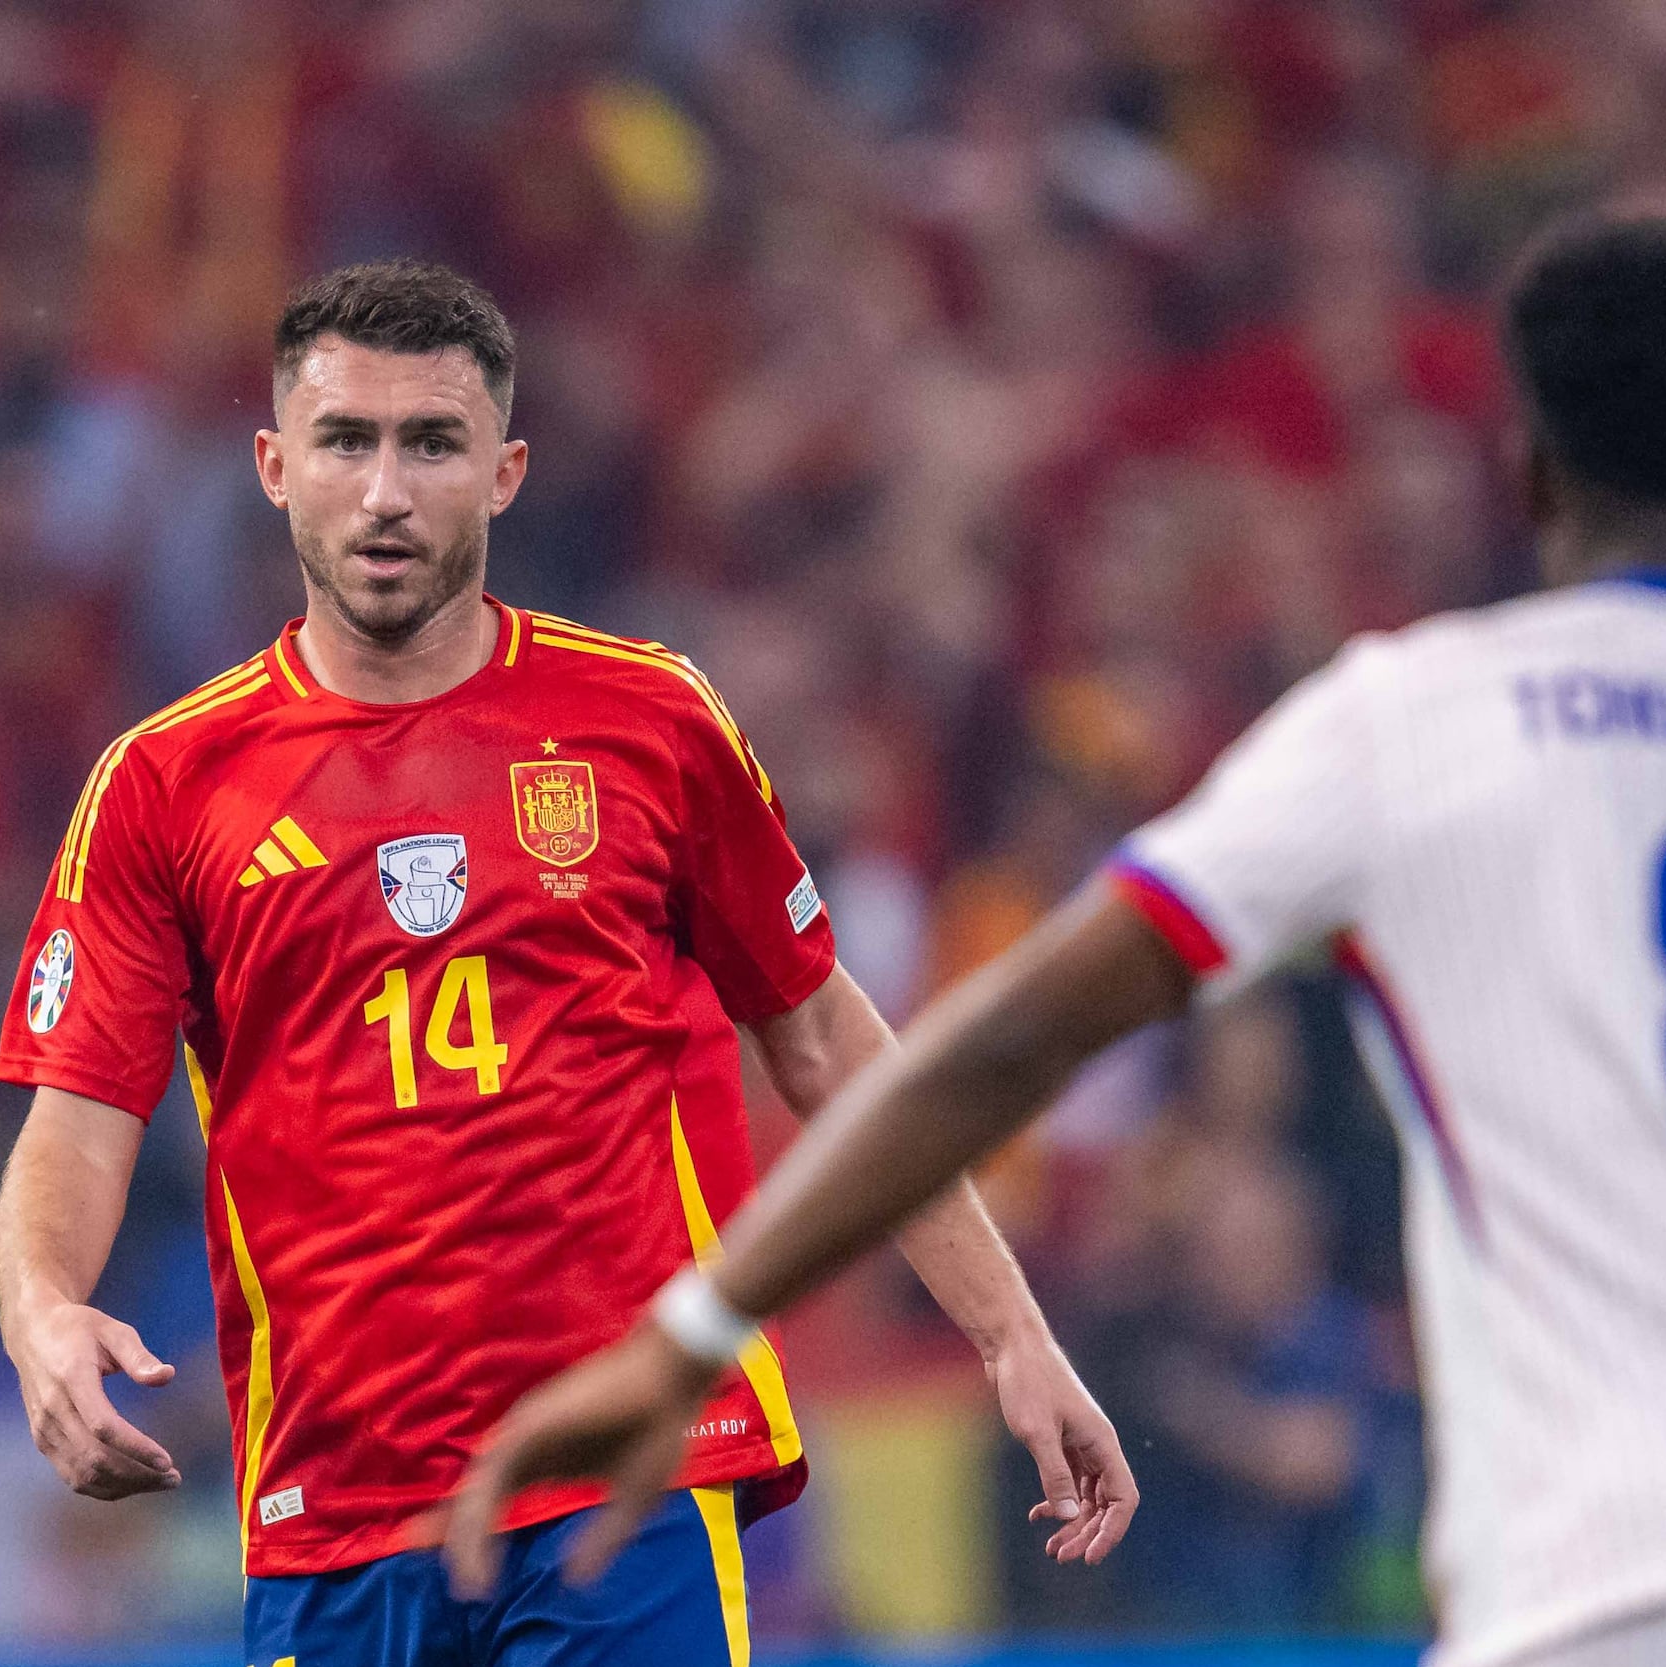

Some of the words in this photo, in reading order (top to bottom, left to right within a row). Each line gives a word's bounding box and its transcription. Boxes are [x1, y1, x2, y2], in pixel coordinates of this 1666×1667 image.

[381, 845, 400, 855] UEFA
[400, 838, 432, 849] NATIONS
[432, 837, 460, 845] LEAGUE
[363, 954, 508, 1109] 14
[720, 1418, 747, 1435] RDY
